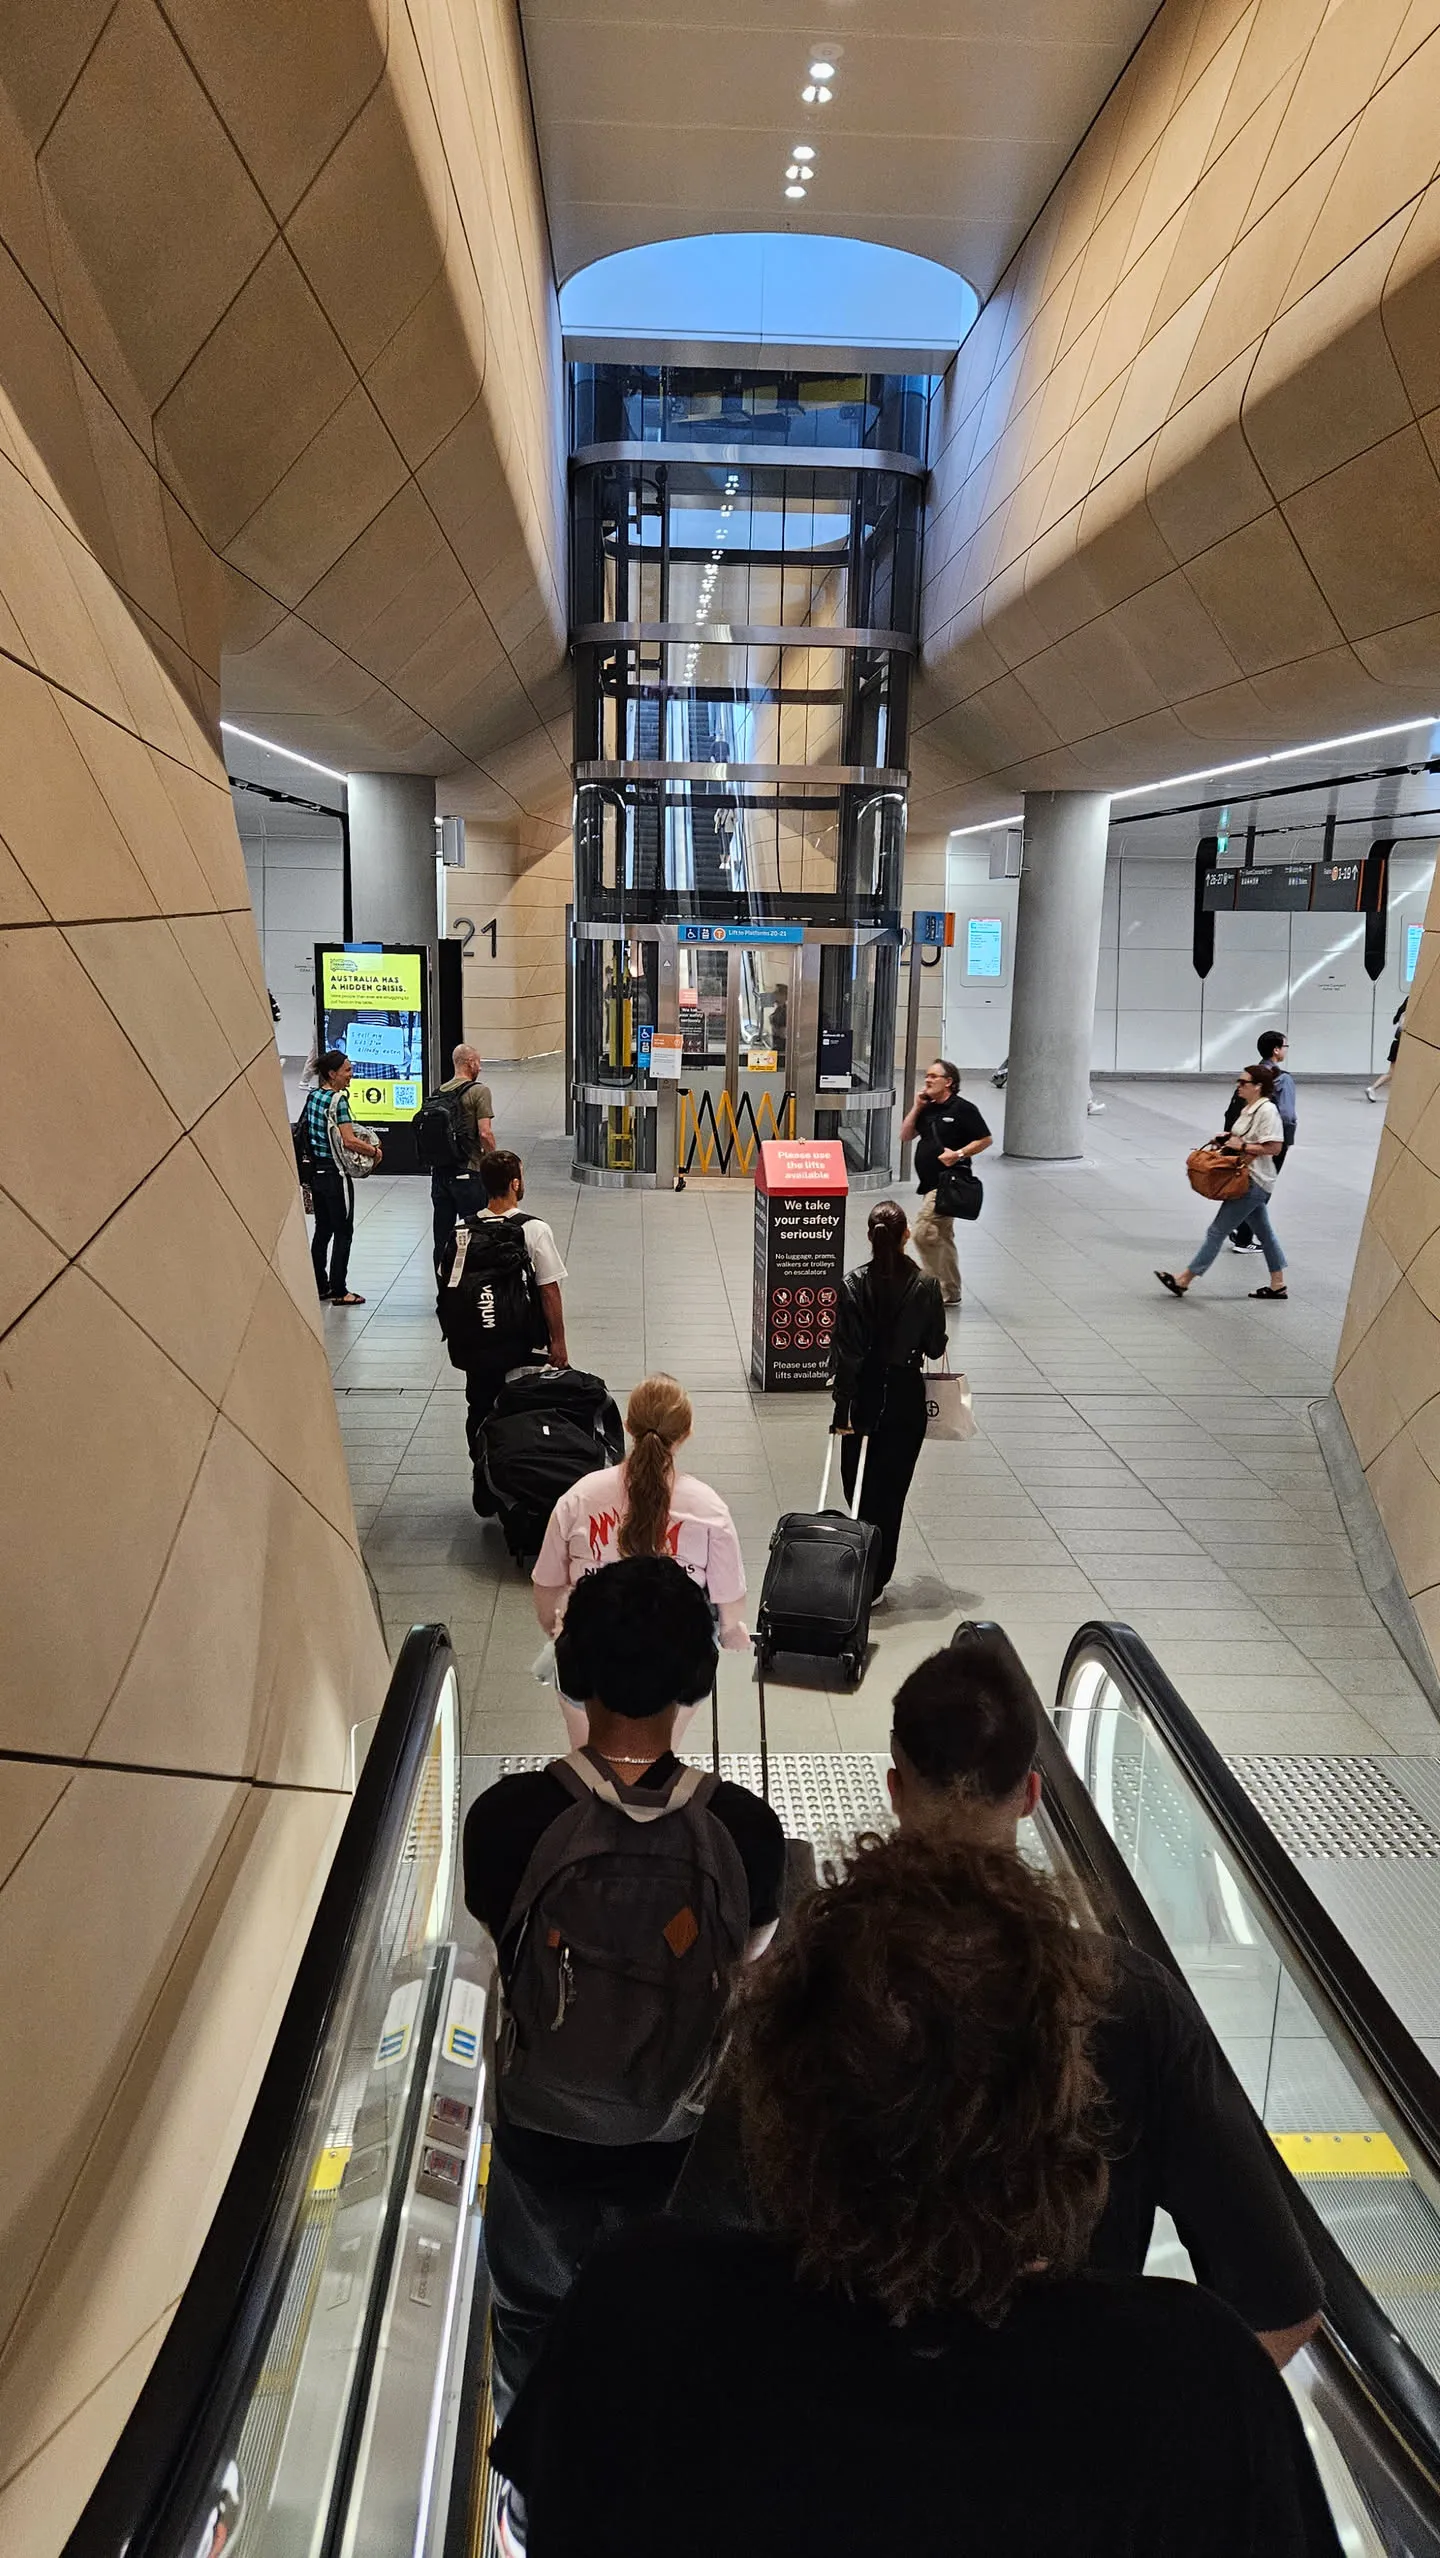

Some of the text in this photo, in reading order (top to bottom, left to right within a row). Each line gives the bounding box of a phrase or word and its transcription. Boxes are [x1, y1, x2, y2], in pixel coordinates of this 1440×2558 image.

[1338, 866, 1351, 880] 1-19
[452, 917, 497, 958] 21
[331, 975, 399, 984] AUSTRALIA HAS
[786, 1161, 825, 1169] the lifts
[784, 1171, 830, 1179] available
[784, 1200, 831, 1210] We take
[774, 1215, 840, 1227] your safety
[780, 1228, 833, 1241] seriously
[477, 1284, 496, 1329] VENUM
[773, 1361, 801, 1369] Please
[775, 1370, 829, 1379] lifts available
